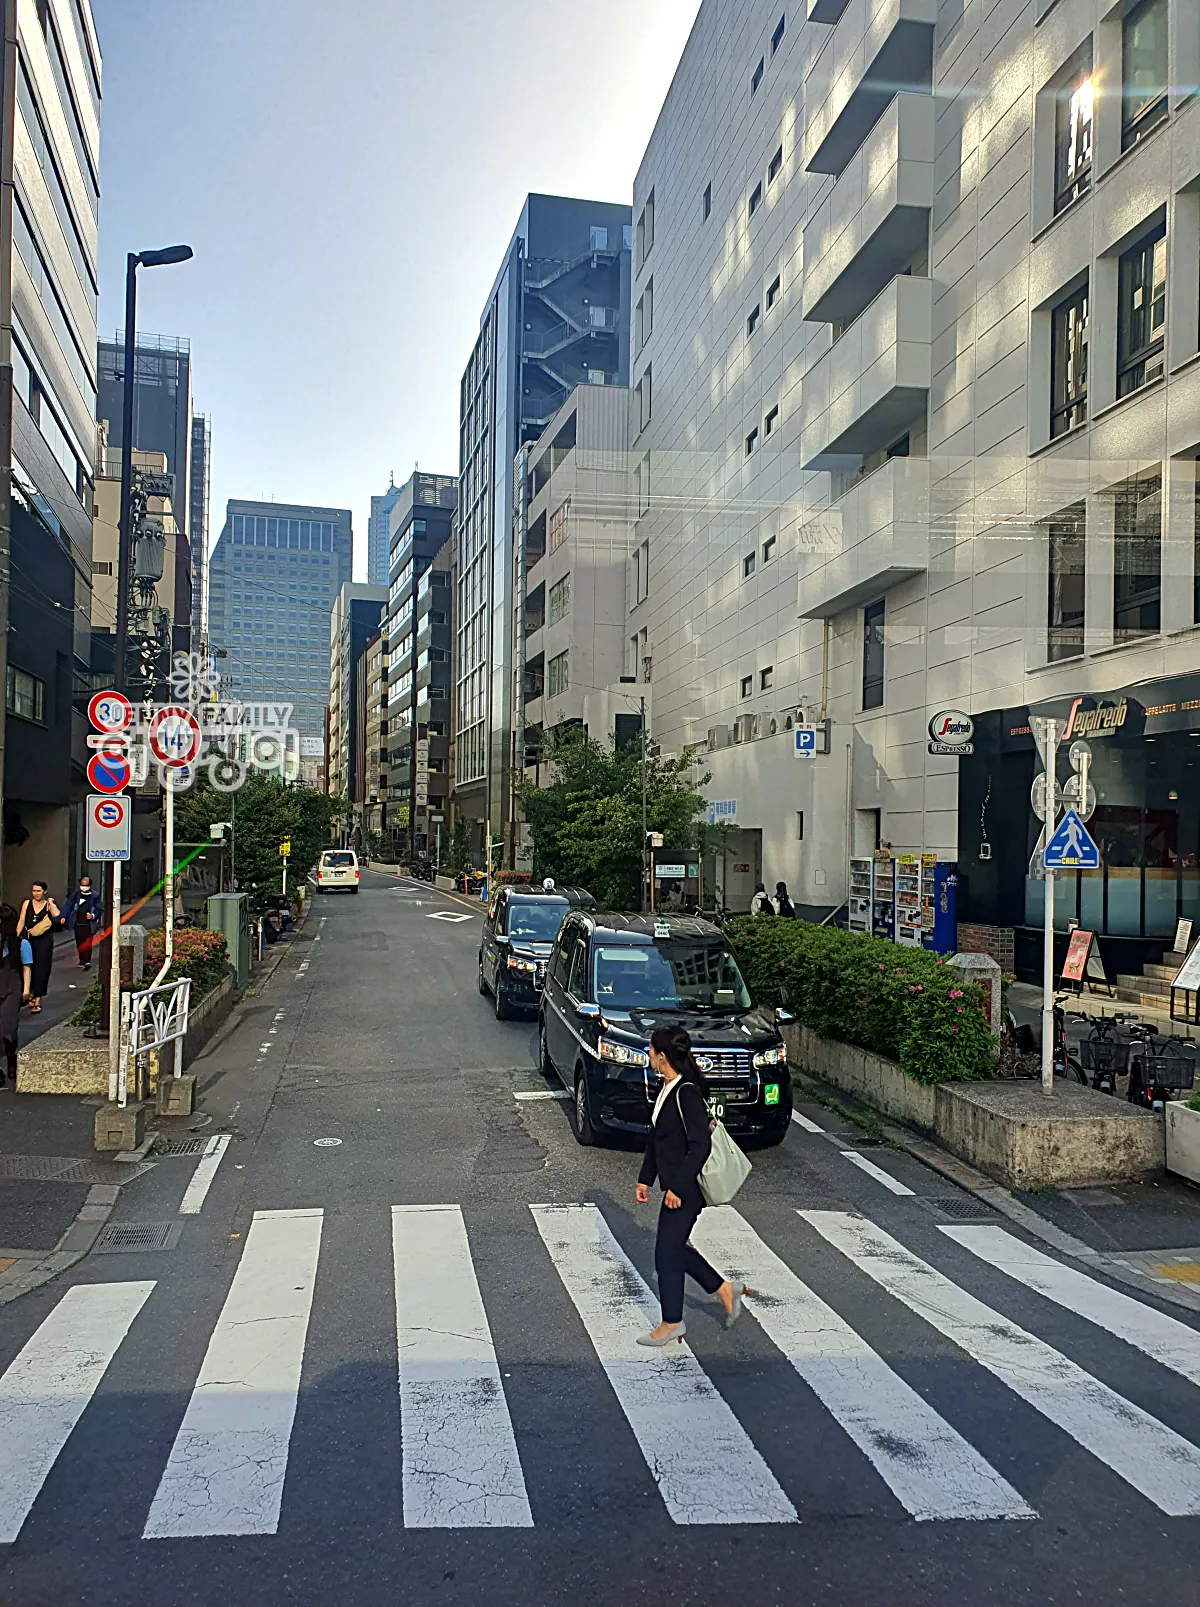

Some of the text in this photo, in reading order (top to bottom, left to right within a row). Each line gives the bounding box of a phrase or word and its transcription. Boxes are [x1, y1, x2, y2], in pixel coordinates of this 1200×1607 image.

[99, 703, 123, 722] 30
[937, 717, 971, 736] Segafredo
[1010, 726, 1032, 736] ESPRESS
[799, 733, 811, 747] P
[936, 744, 971, 752] ESPRESSO
